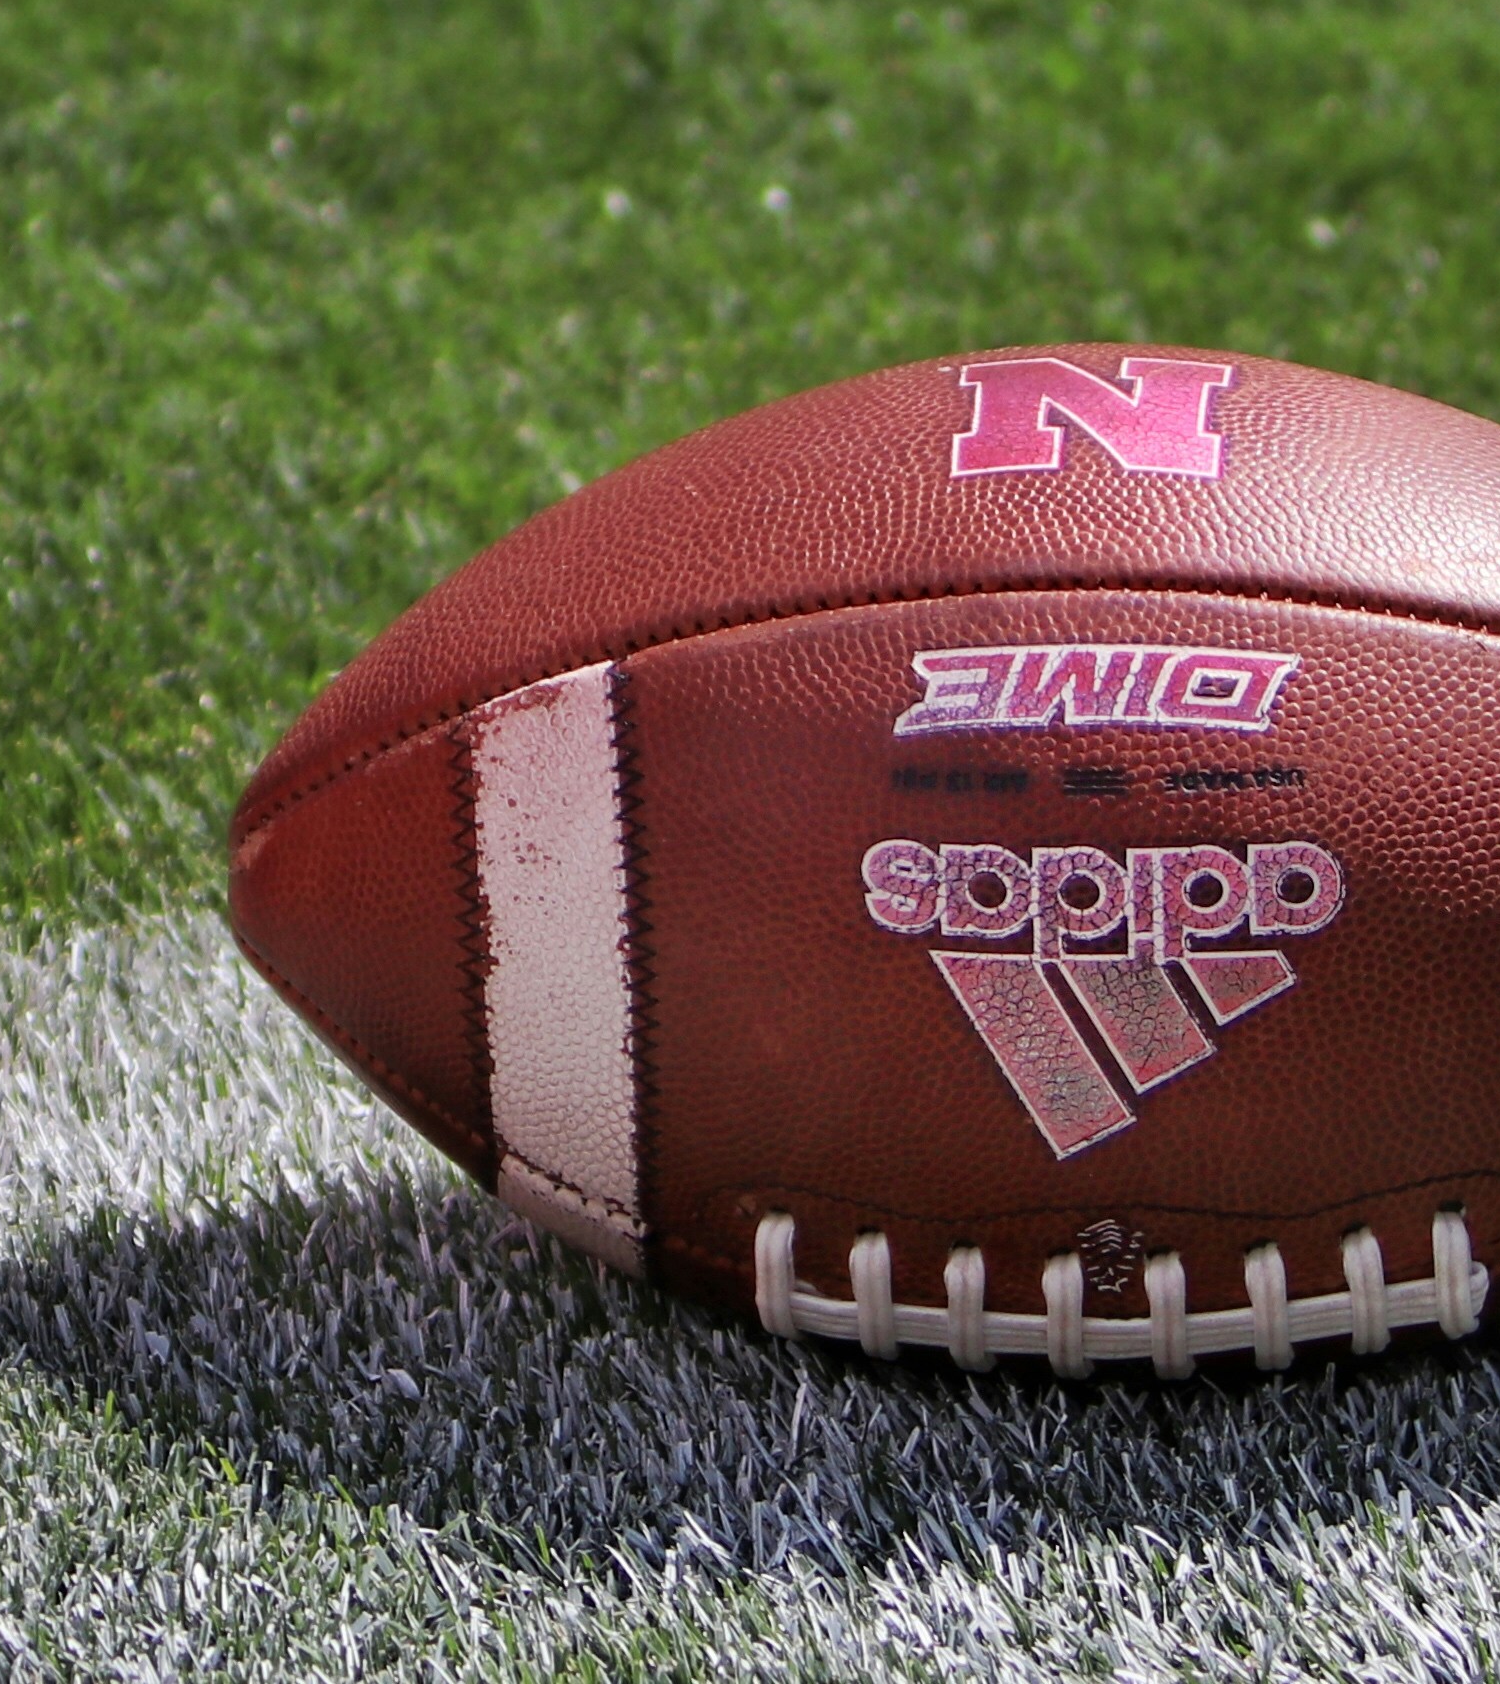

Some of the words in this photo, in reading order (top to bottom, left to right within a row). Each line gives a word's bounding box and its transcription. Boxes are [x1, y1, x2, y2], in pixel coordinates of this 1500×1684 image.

[950, 356, 1232, 478] N
[892, 644, 1301, 737] DIME
[1165, 772, 1245, 794] MADE
[1251, 770, 1306, 790] USA
[860, 839, 1345, 962] adidas
